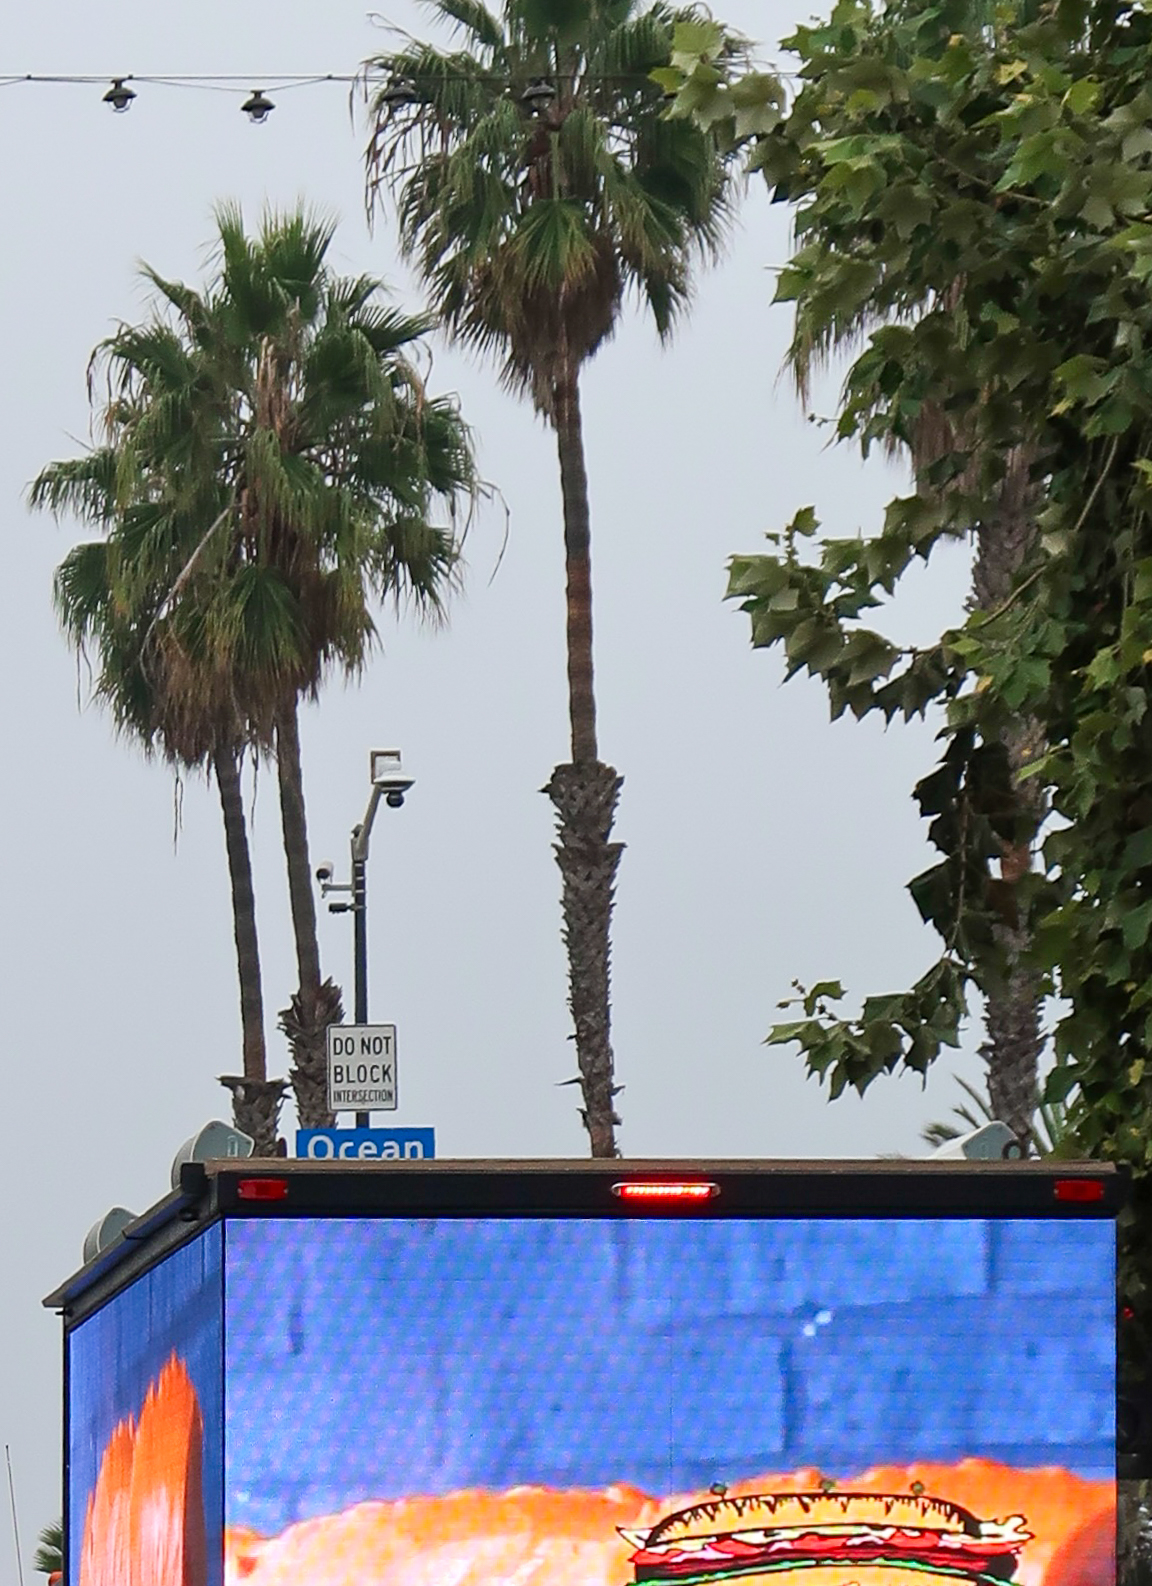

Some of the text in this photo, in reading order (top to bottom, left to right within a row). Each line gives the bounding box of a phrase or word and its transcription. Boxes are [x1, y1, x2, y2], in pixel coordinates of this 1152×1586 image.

[333, 1036, 392, 1056] DO NOT
[333, 1064, 392, 1084] BLOCK
[333, 1089, 394, 1104] INTERSECTION
[307, 1135, 424, 1160] Ocean
